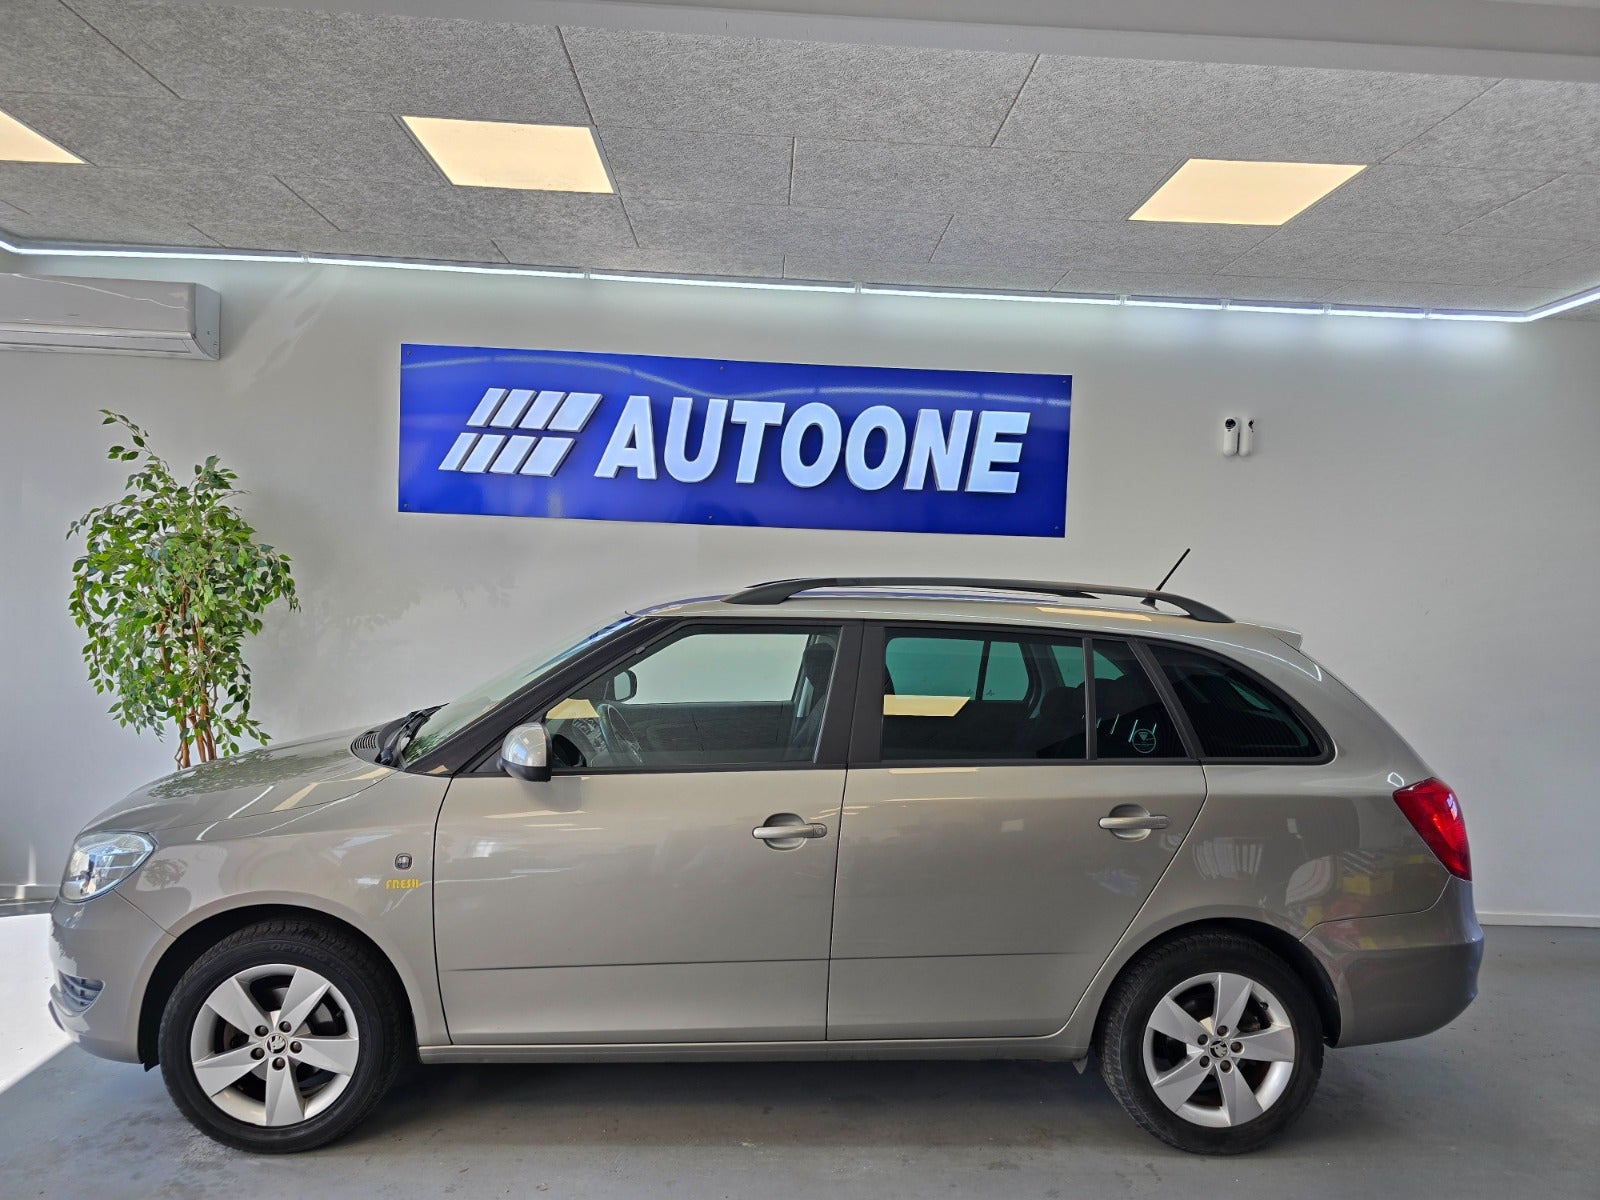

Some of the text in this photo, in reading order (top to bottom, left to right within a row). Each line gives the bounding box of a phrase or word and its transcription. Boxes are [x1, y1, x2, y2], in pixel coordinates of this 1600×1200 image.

[593, 395, 1031, 494] AUTOONE
[385, 879, 420, 890] FRESH
[269, 943, 328, 962] OPTIMO
